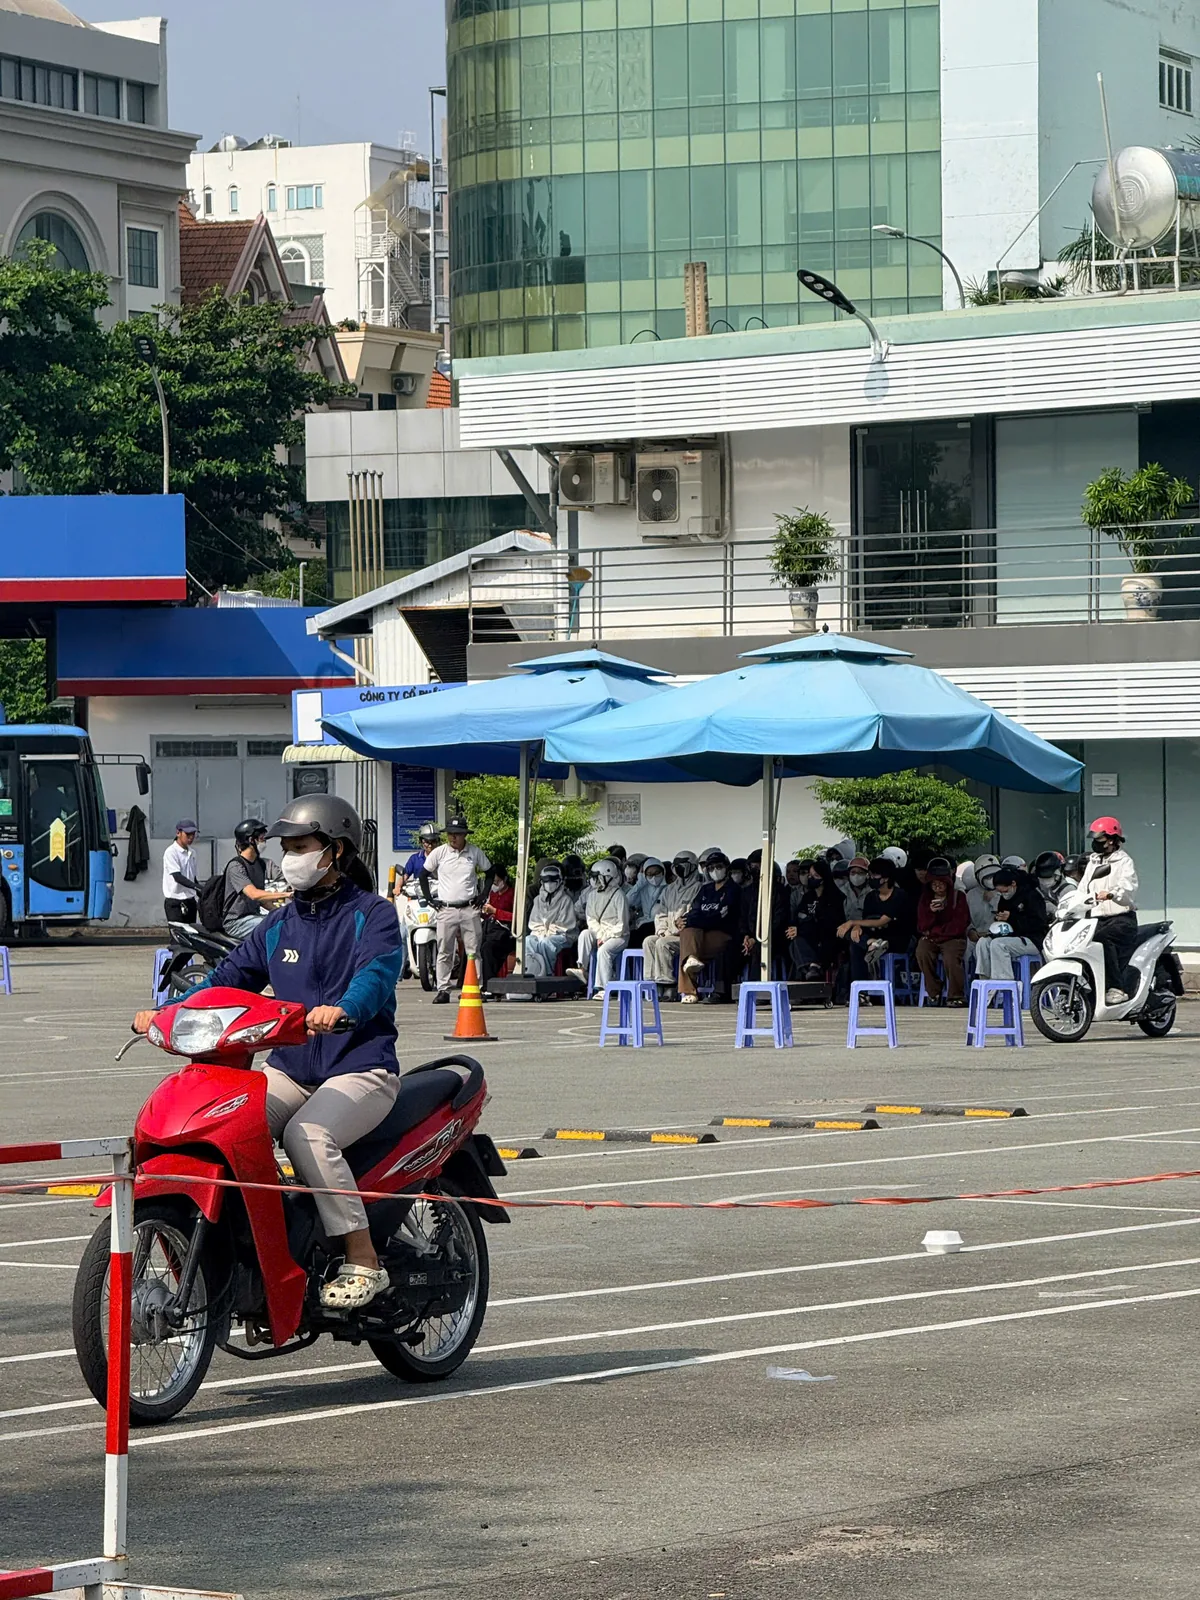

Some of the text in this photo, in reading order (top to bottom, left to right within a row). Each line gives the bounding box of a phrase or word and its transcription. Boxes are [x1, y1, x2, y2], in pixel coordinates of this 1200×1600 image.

[359, 690, 385, 702] CÔNG
[387, 691, 400, 701] TY
[402, 686, 417, 699] CỔ
